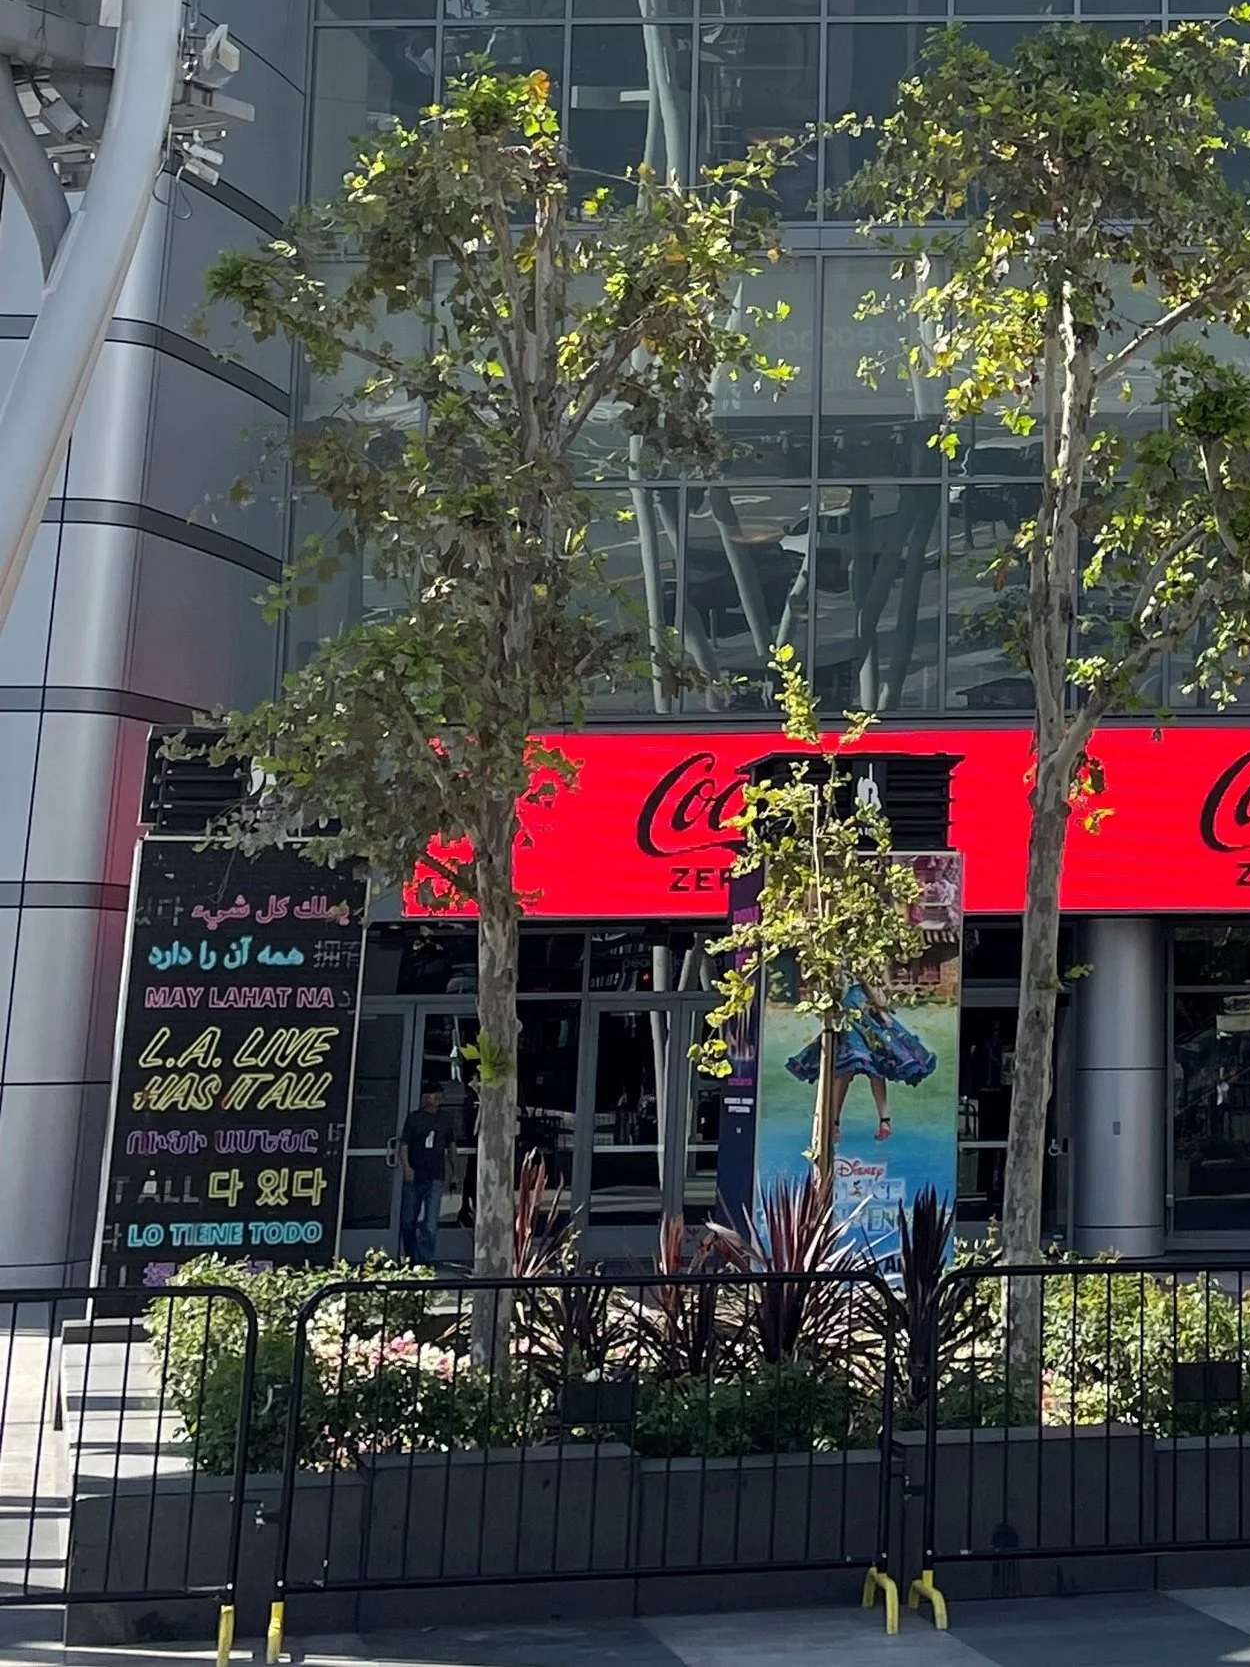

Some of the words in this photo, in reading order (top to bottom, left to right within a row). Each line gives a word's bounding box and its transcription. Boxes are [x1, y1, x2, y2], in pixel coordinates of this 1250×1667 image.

[191, 894, 250, 931] شيء
[256, 895, 290, 924] كل
[148, 940, 192, 970] دارد
[200, 940, 216, 971] را
[224, 935, 253, 970] آن
[257, 944, 304, 966] همه
[145, 987, 204, 1009] MAY
[208, 987, 292, 1009] LAHAT
[296, 987, 335, 1009] NA
[138, 1026, 222, 1069] L.A.
[233, 1026, 340, 1068] LIVE
[132, 1072, 222, 1111] HAS
[221, 1073, 275, 1111] IT
[256, 1072, 333, 1110] ALL
[208, 1168, 244, 1207] 다
[255, 1167, 328, 1207] 있다
[127, 1223, 164, 1248] LO
[169, 1222, 244, 1246] TIENE
[248, 1221, 323, 1245] TODO
